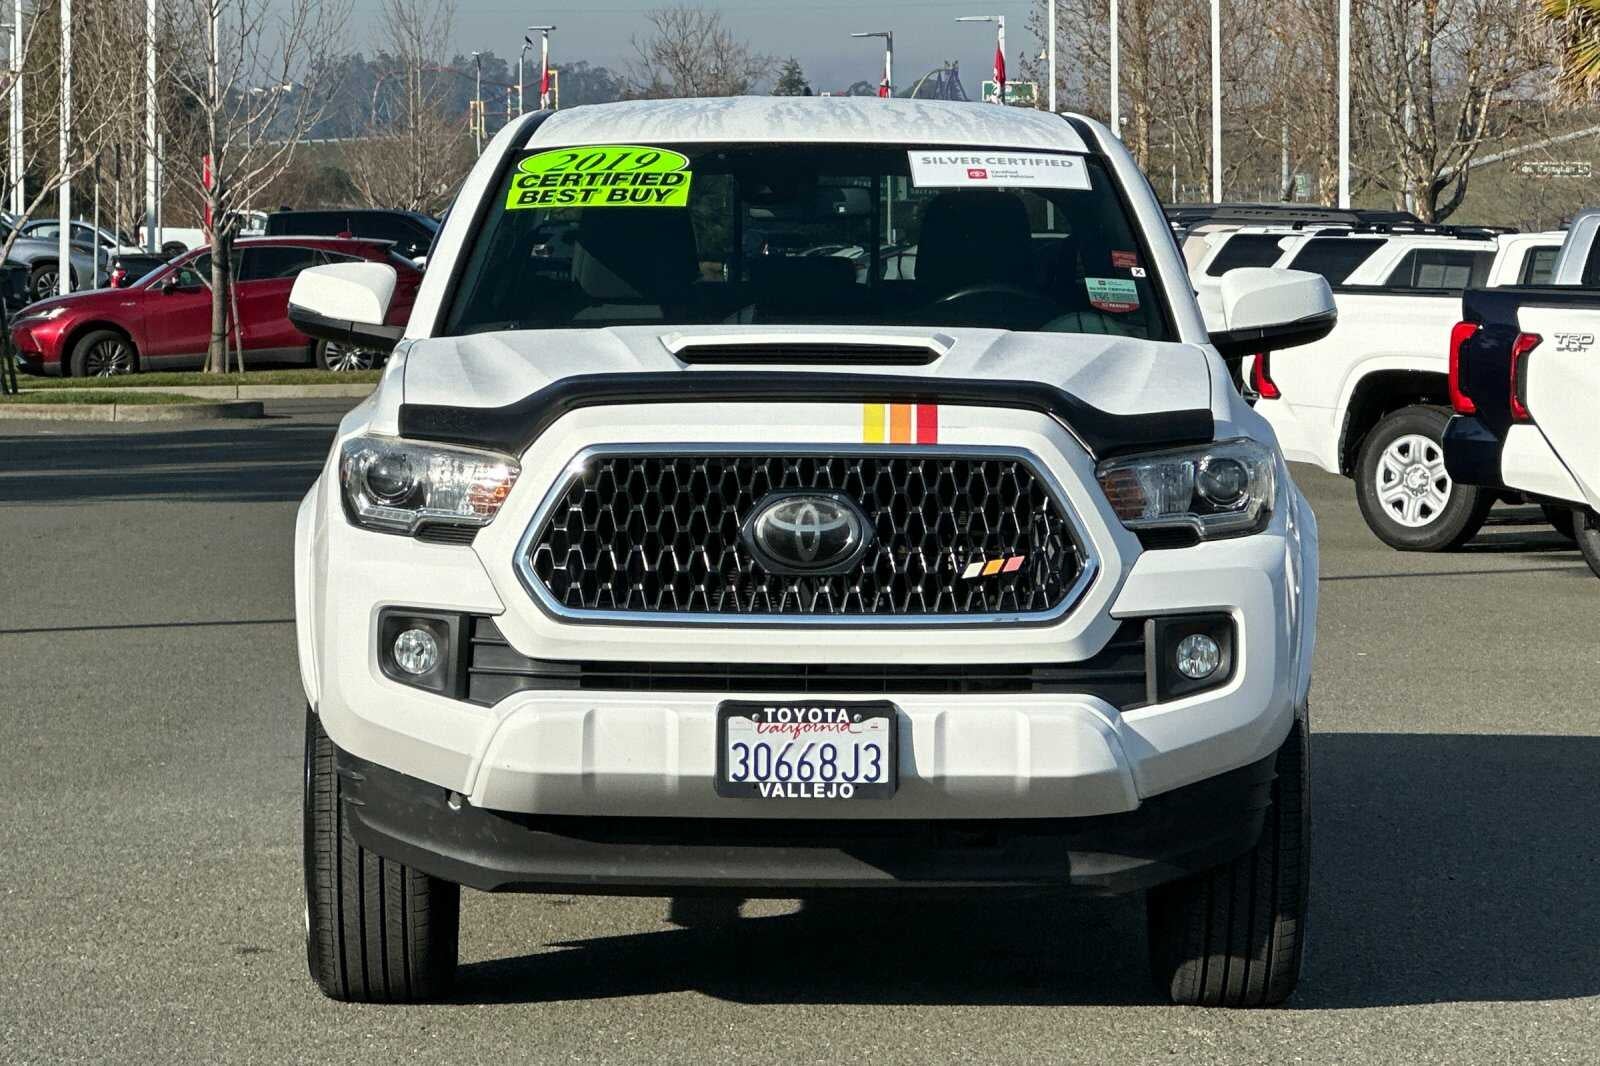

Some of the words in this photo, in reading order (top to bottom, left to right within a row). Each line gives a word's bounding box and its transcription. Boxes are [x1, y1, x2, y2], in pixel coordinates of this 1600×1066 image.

[545, 152, 662, 172] 2019
[922, 156, 982, 165] SILVER
[985, 157, 1073, 168] CERTIFIED
[517, 172, 686, 189] CERTIFIED
[516, 188, 600, 205] BEST
[606, 187, 675, 203] BUY
[1554, 333, 1595, 348] TRD
[764, 708, 849, 723] TOYOTA
[756, 721, 863, 740] California
[731, 742, 881, 782] 30668J3
[759, 782, 854, 798] VALLEJO
